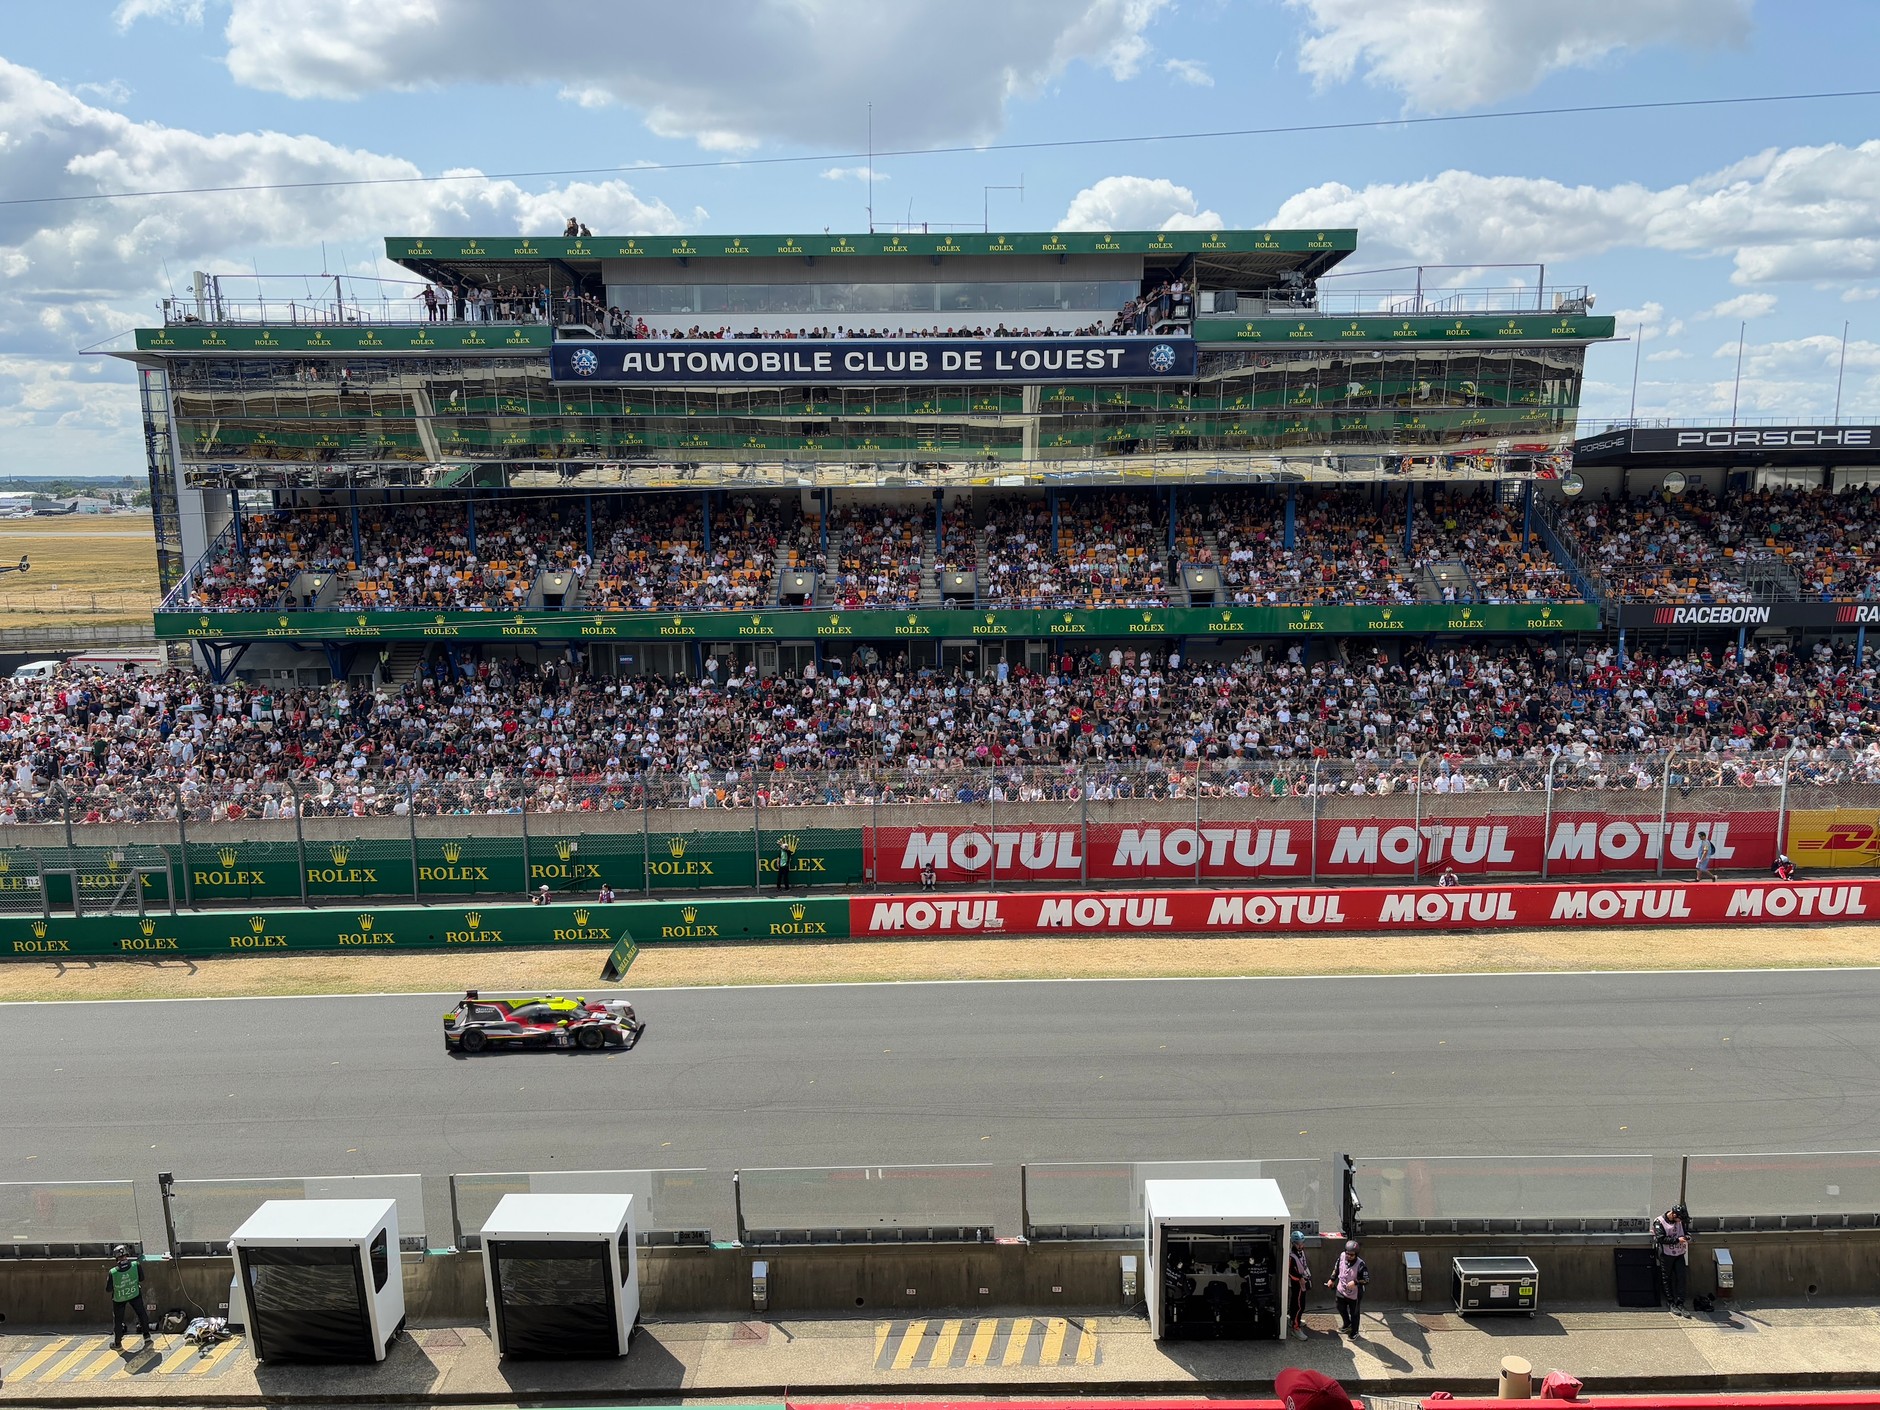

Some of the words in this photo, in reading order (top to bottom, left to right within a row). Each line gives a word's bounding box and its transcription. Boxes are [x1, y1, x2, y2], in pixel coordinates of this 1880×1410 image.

[990, 244, 1014, 252] ROLEX
[622, 352, 832, 372] AUTOMOBILE
[844, 352, 928, 372] CLUB
[942, 351, 982, 371] DE
[995, 348, 1126, 371] L'OUEST
[1677, 430, 1872, 447] PORSCHE
[1580, 437, 1625, 454] PORSCHE
[1672, 606, 1770, 624] RACEBORN
[1855, 605, 1880, 623] RA
[1528, 620, 1562, 628] ROLEX
[424, 627, 458, 635] ROLEX
[502, 627, 537, 635] ROLEX
[582, 627, 616, 635] ROLEX
[661, 627, 695, 635] ROLEX
[740, 627, 773, 635] ROLEX
[818, 627, 852, 635] ROLEX
[1328, 825, 1514, 864] MOTUL
[1547, 822, 1736, 860] MOTUL
[900, 831, 1083, 871] MOTUL
[1112, 829, 1298, 867] MOTUL
[420, 867, 489, 880] ROLEX
[532, 864, 602, 878] ROLEX
[643, 861, 714, 875] ROLEX
[196, 871, 265, 885] ROLEX
[307, 869, 377, 883] ROLEX
[1378, 892, 1517, 922] MOTUL
[1550, 890, 1691, 919] MOTUL
[1725, 886, 1867, 917] MOTUL
[868, 901, 1004, 930] MOTUL
[1037, 898, 1174, 926] MOTUL
[1207, 896, 1345, 924] MOTUL
[554, 929, 611, 940] ROLEX
[662, 925, 719, 937] ROLEX
[770, 922, 826, 934] ROLEX
[230, 935, 288, 947] ROLEX
[338, 933, 395, 944] ROLEX
[446, 931, 503, 942] ROLEX
[13, 940, 69, 951] ROLEX
[121, 938, 178, 949] ROLEX
[557, 1037, 568, 1045] 16
[118, 1286, 136, 1297] 1126
